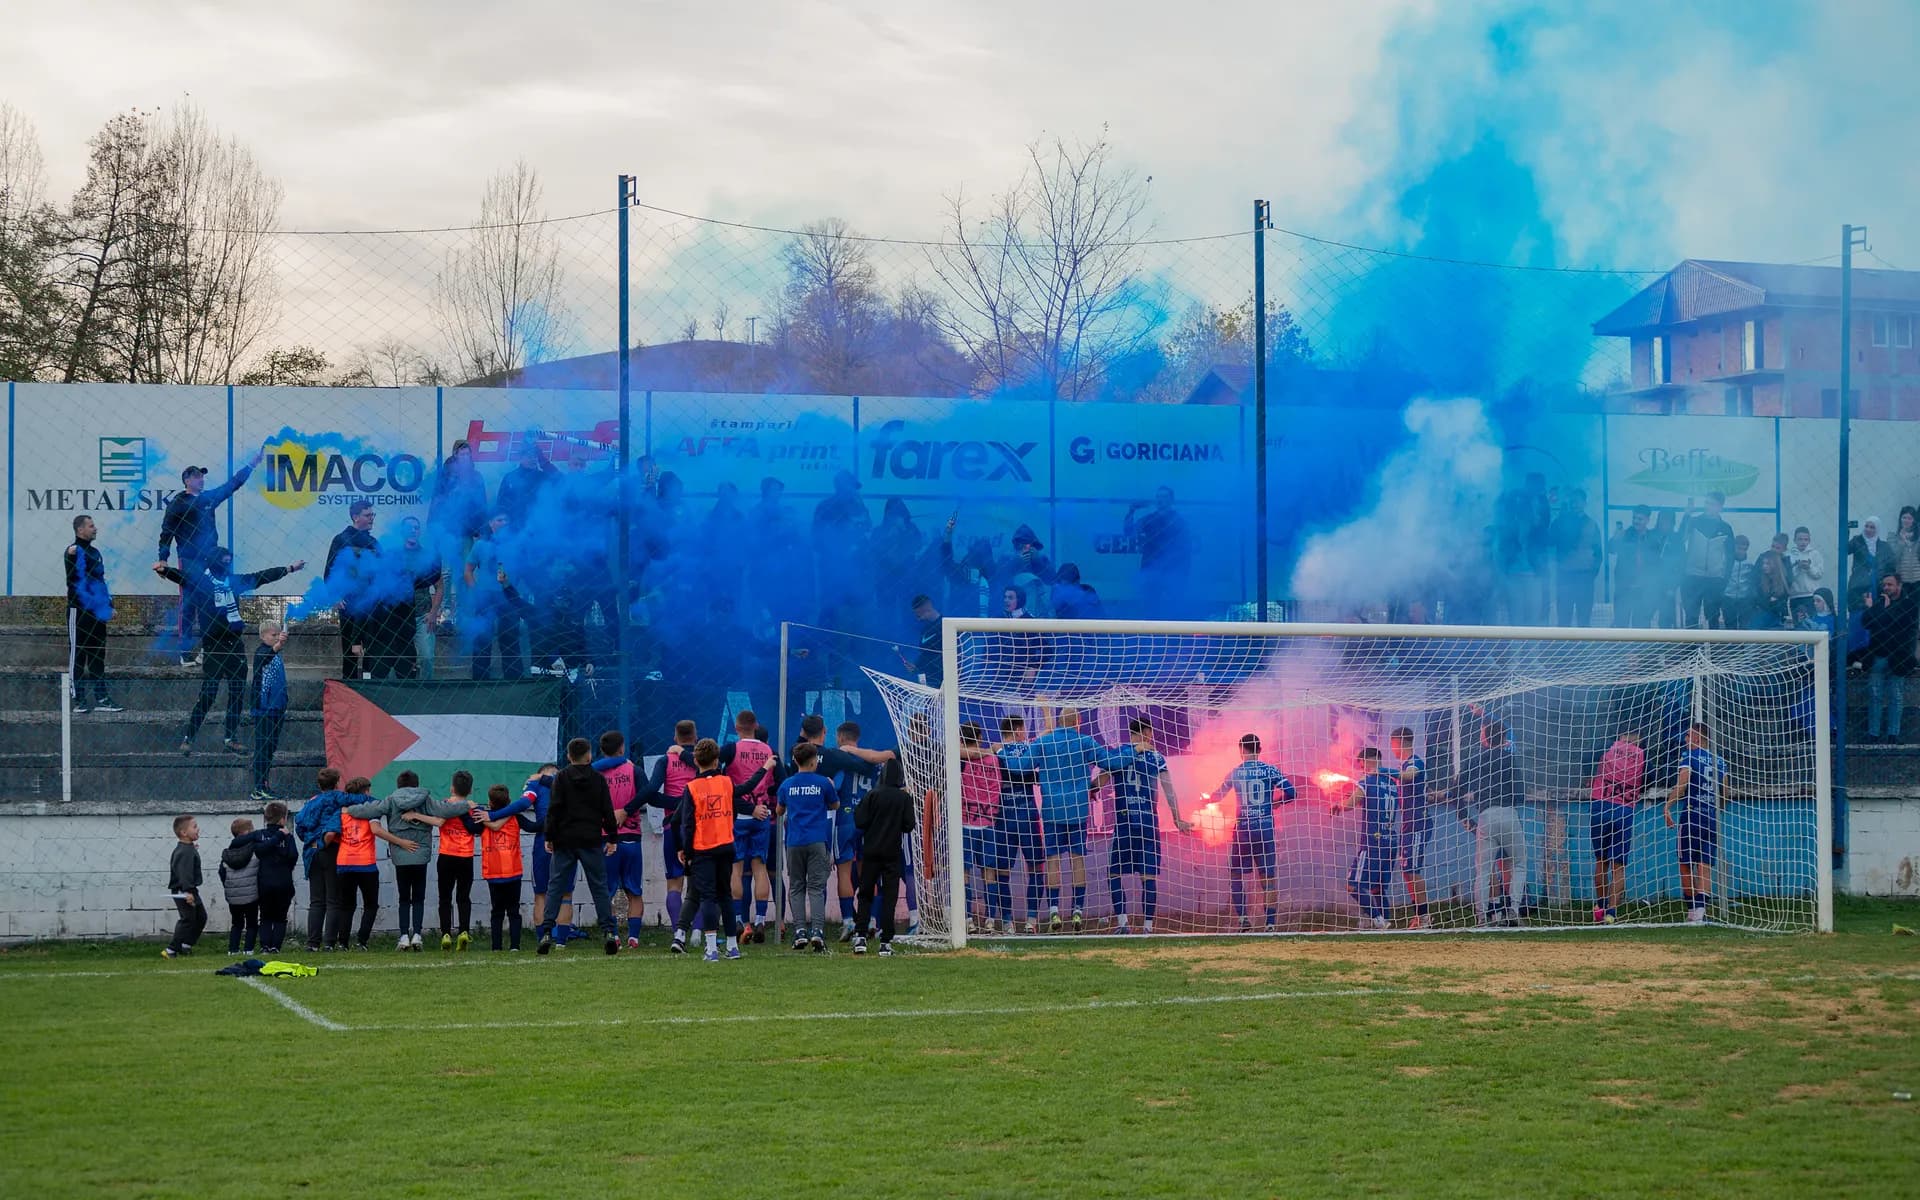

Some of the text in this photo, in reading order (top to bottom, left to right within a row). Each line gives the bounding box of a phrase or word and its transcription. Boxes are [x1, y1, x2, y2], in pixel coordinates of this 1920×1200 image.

[870, 420, 1039, 482] farex
[1106, 442, 1225, 463] GORICIANA
[266, 453, 424, 493] IMACO
[27, 488, 177, 511] METALSK
[318, 494, 424, 505] SYSTEMTECHNIK
[789, 784, 821, 796] NK TOŠK
[852, 773, 873, 794] 14
[1239, 780, 1265, 805] 10
